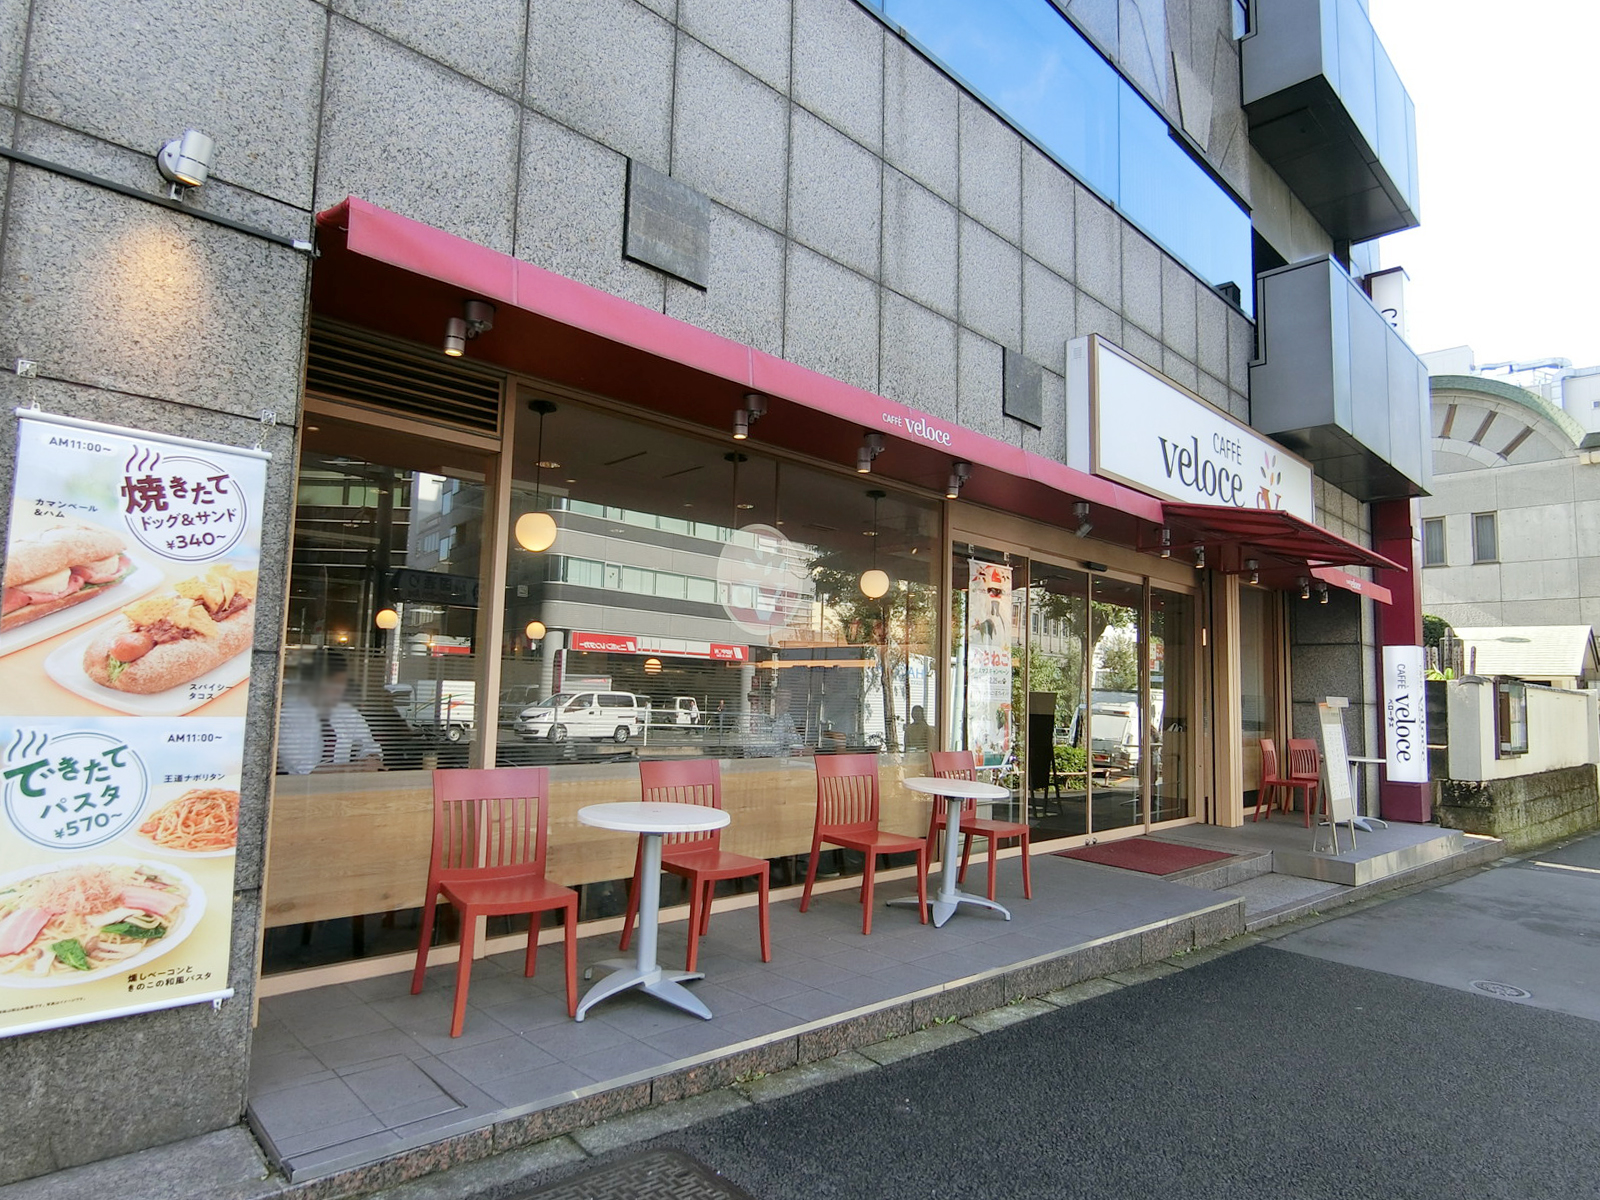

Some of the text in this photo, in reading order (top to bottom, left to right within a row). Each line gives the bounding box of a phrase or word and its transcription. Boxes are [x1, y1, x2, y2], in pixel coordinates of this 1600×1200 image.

[882, 412, 952, 446] CAFFÈ veloce
[1212, 432, 1242, 465] CAFFÈ
[1157, 435, 1245, 508] veloce
[35, 499, 99, 513] カマンベール
[121, 474, 230, 514] 焼きたて
[141, 508, 237, 532] ドッグ&サンド
[189, 692, 215, 701] タコス
[1395, 694, 1416, 763] veloce
[3, 744, 129, 798] できたて
[163, 773, 226, 784] 王道ナポリタン
[40, 784, 121, 819] パスタ
[128, 971, 212, 992] きのこの和風パスタ
